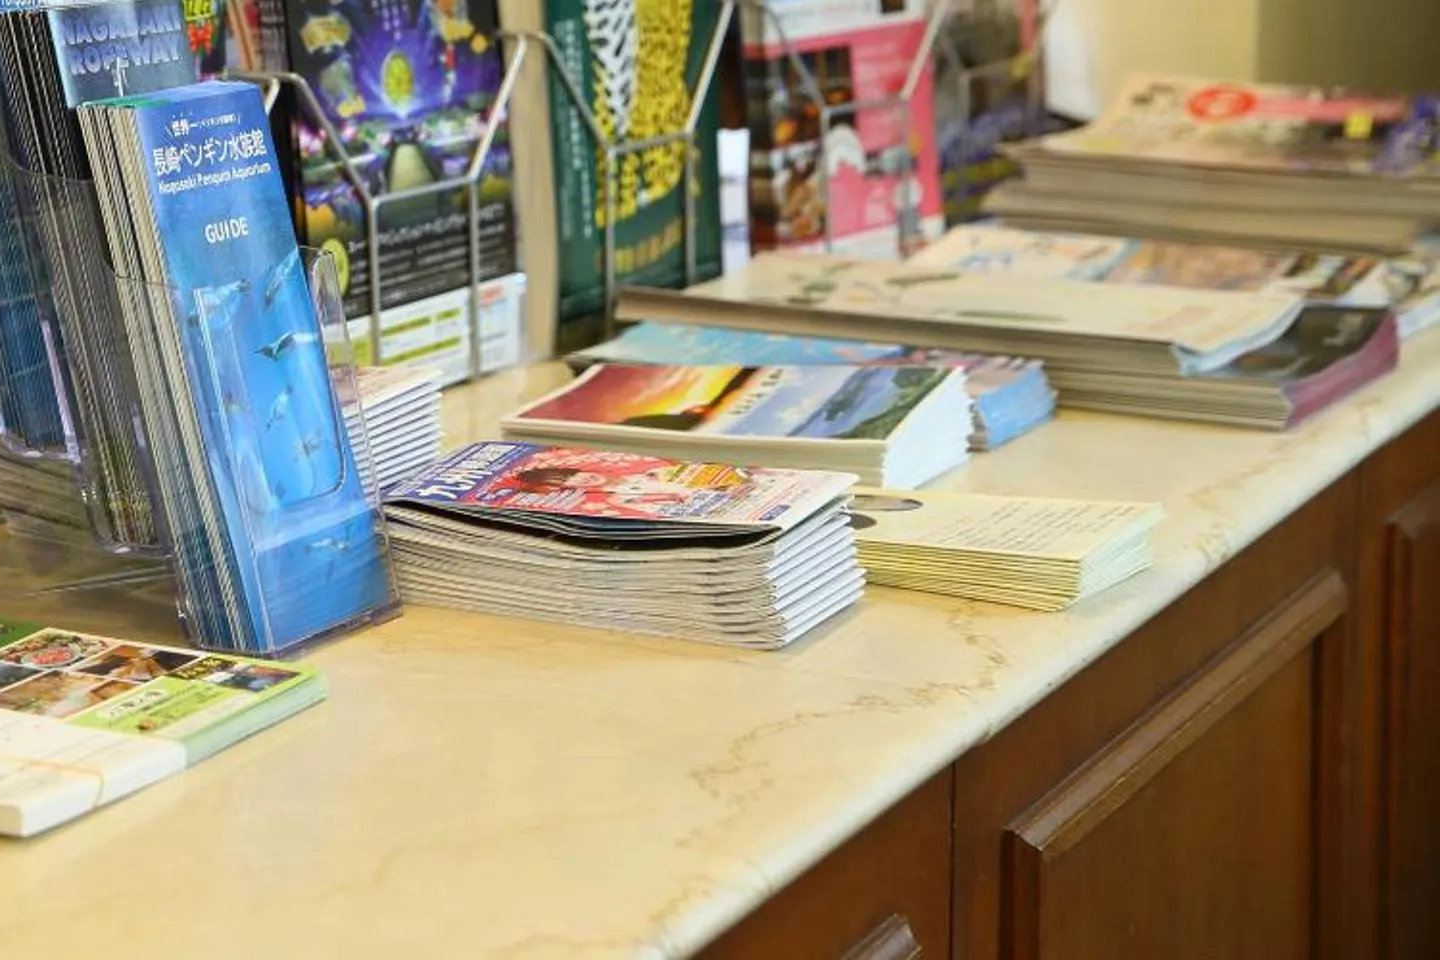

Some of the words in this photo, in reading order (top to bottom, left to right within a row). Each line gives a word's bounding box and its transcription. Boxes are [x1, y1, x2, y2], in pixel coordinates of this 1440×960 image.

[153, 128, 268, 176] 長崎ペンギン水族館
[158, 177, 197, 195] Nagasaki
[205, 216, 249, 243] GUIDE
